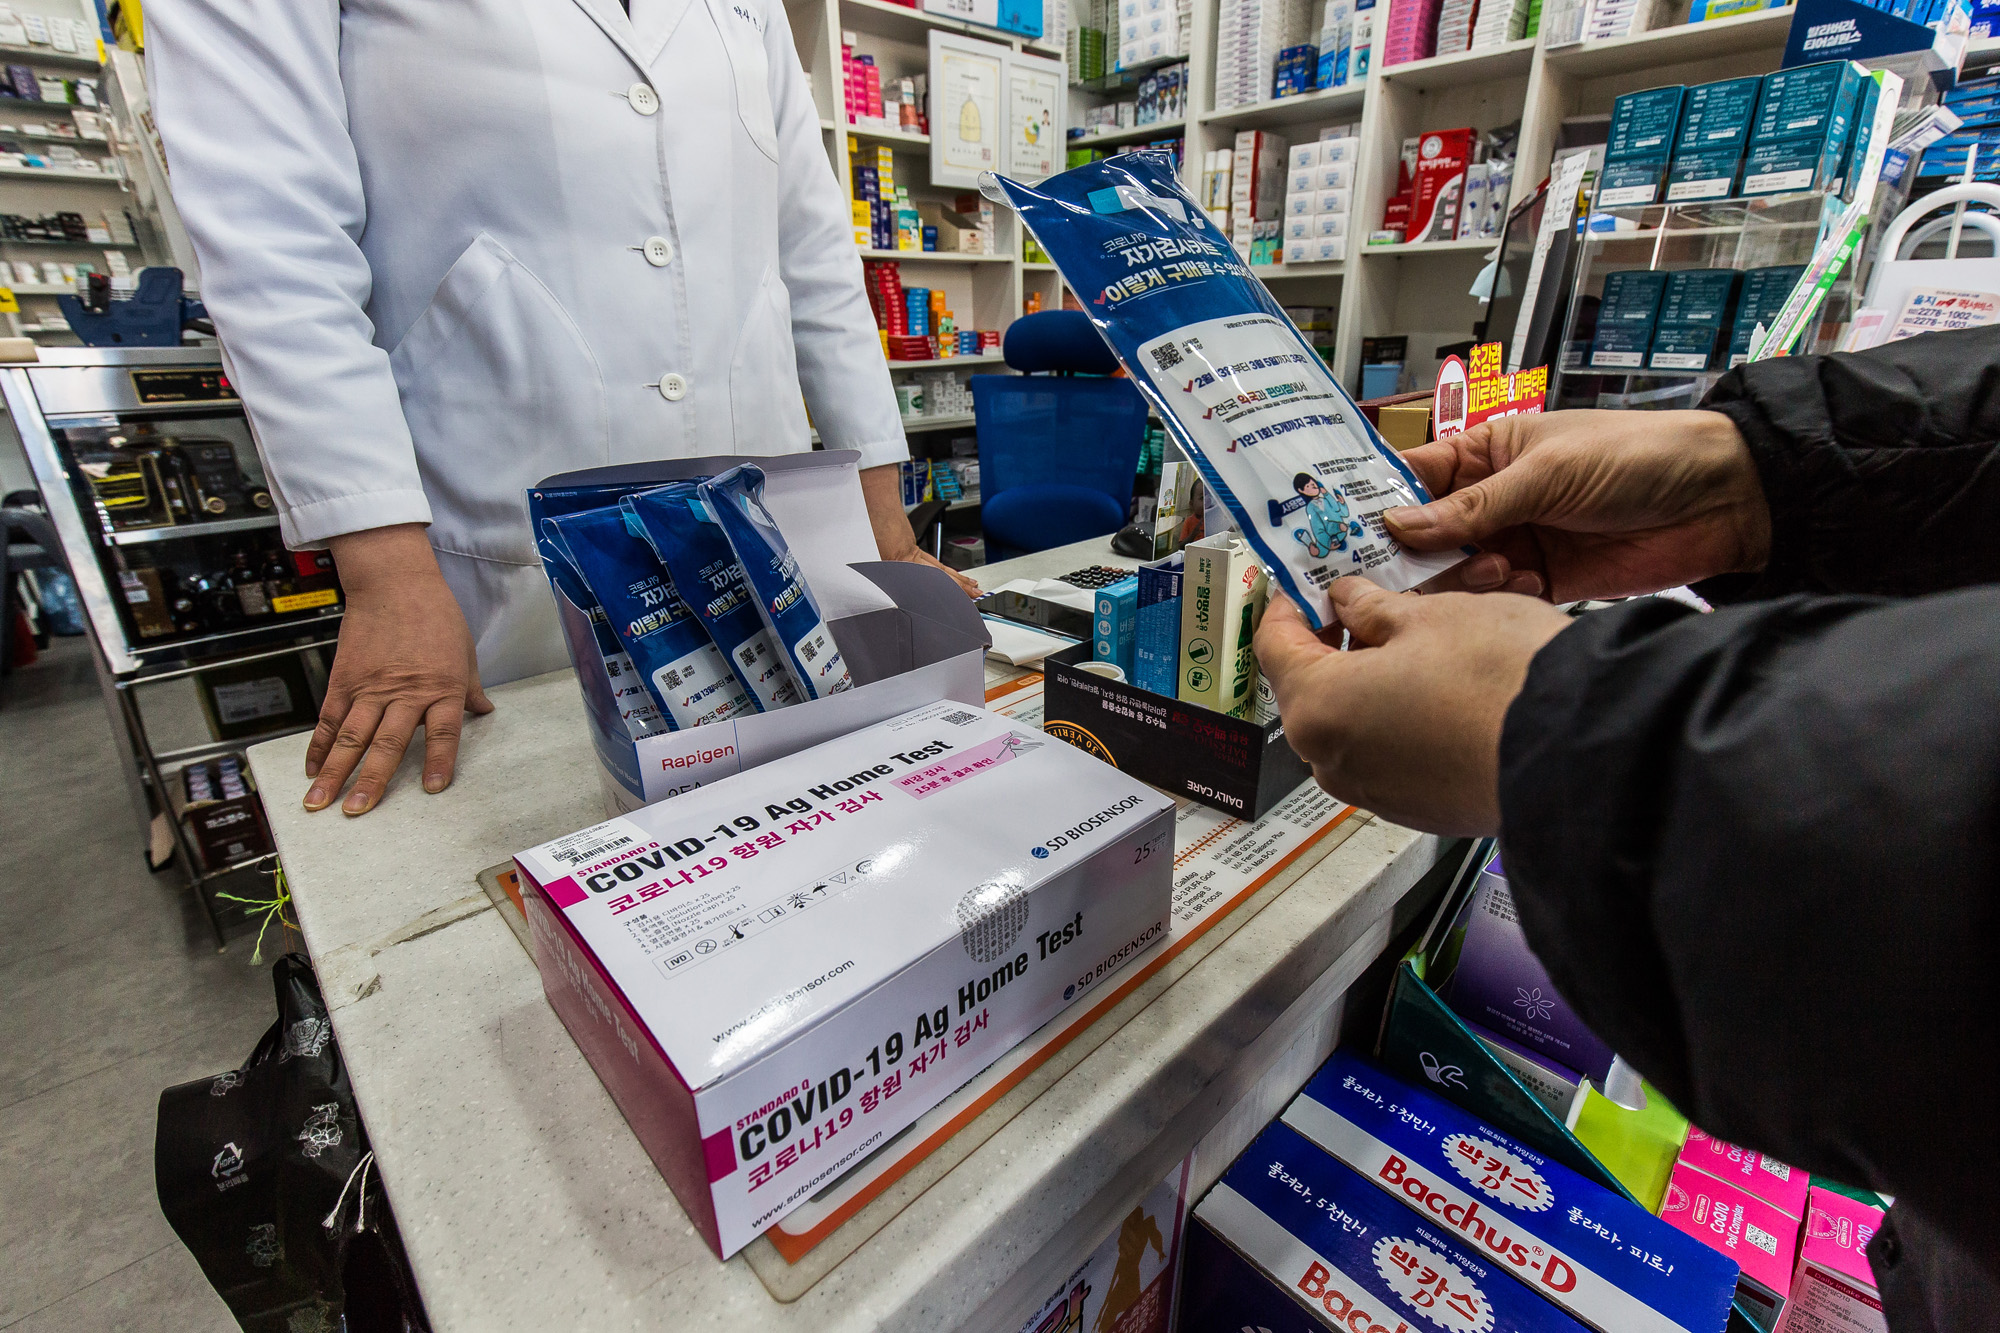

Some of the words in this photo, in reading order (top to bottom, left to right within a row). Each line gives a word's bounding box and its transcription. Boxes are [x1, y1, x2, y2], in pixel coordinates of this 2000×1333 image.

[1103, 232, 1147, 250] 코로나19
[1105, 270, 1167, 303] 이렇게
[1163, 260, 1214, 282] 구매할
[1213, 261, 1227, 276] 수
[1194, 372, 1215, 389] 2월
[1250, 357, 1266, 371] 3월
[1265, 354, 1293, 369] 5일까지
[1468, 343, 1502, 380] 초강력
[1212, 397, 1240, 418] 전국
[1265, 381, 1309, 400] 편의점에서
[1468, 365, 1548, 414] 피로회복&피부탄력
[1236, 428, 1258, 449] 1인
[1256, 426, 1275, 443] 1회
[1271, 417, 1307, 437] 5개까지
[1312, 463, 1324, 477] 1
[1339, 484, 1350, 498] 2
[1357, 514, 1368, 529] 3
[1351, 549, 1362, 565] 4
[1303, 571, 1315, 586] 5
[707, 589, 740, 617] 이렇게
[773, 583, 802, 613] 이렇게
[1195, 585, 1210, 627] 활명수
[630, 608, 673, 637] 이렇게
[631, 706, 650, 719] 전국
[1145, 713, 1167, 730] 백수오
[661, 744, 735, 772] Rapigen
[900, 773, 922, 787] 비강
[922, 765, 947, 779] 검사
[914, 780, 942, 796] 15분
[941, 775, 953, 784] 후
[951, 765, 975, 779] 결과
[970, 756, 996, 770] 확인
[1187, 779, 1214, 798] CARE
[1214, 790, 1244, 809] DAILY
[1271, 806, 1285, 818] MIA
[1282, 799, 1293, 811] Vita
[1299, 784, 1319, 799] Balance
[1281, 811, 1294, 822] MIA
[1291, 802, 1308, 816] Kinder
[1305, 790, 1325, 805] Balance
[1300, 819, 1313, 830] MIA
[1310, 809, 1327, 824] Kinder
[1325, 800, 1340, 814] Chew
[1311, 796, 1331, 811] Balance
[585, 815, 761, 894] COVID-19
[764, 797, 813, 821] Ag
[807, 762, 895, 801] Home
[889, 739, 955, 766] Test
[1046, 835, 1069, 852] SD
[1064, 794, 1145, 842] BIOSENSOR
[606, 856, 728, 916] 코로나19
[729, 830, 787, 861] 항원
[784, 809, 837, 836] 자가
[834, 789, 884, 814] 검사
[1133, 841, 1151, 866] 25
[1211, 850, 1224, 862] MIA
[1221, 840, 1236, 855] Joint
[1233, 827, 1256, 844] Balance
[1251, 820, 1268, 833] Gold
[1220, 855, 1233, 867] MIA
[1231, 849, 1243, 860] NB
[1239, 839, 1257, 854] GOLD
[1230, 859, 1244, 871] MIA
[1240, 852, 1253, 864] Fem
[1252, 837, 1275, 855] Balance
[1272, 830, 1286, 842] Plus
[577, 844, 647, 878] STANDARD
[648, 840, 661, 852] Q
[1240, 864, 1254, 876] MIA
[1252, 856, 1265, 869] Max
[1202, 869, 1217, 883] Gold
[666, 901, 704, 923] (Solution
[703, 892, 725, 908] tube)
[671, 911, 702, 928] (Nozzle
[701, 901, 720, 913] cap)
[1172, 903, 1186, 916] MIA
[1184, 889, 1207, 908] Omega
[1181, 909, 1195, 922] MIA
[1193, 901, 1205, 913] BR
[1202, 890, 1223, 907] Focus
[669, 954, 688, 967] IVD
[1077, 971, 1094, 992] SD
[1095, 921, 1162, 979] BIOSENSOR
[711, 957, 857, 1044] www.sdosensor.com
[739, 1031, 904, 1162] COVID-19
[912, 1004, 949, 1049] Ag
[957, 952, 1029, 1017] Home
[1035, 911, 1083, 961] Test
[736, 1086, 798, 1131] STANDARD
[801, 1078, 810, 1091] Q
[747, 1107, 855, 1194] 코로나19
[858, 1068, 903, 1116] 항원
[907, 1038, 949, 1079] 자가
[953, 1007, 990, 1049] 검사
[1342, 1074, 1385, 1113] 풀려라,
[1478, 1125, 1508, 1145] 피로회복
[1513, 1144, 1545, 1166] 자양강장
[220, 1155, 236, 1169] HDPE
[1456, 1139, 1540, 1200] 박카스
[751, 1129, 883, 1230] www.sdbiosensor.com
[1267, 1160, 1314, 1205] 풀려라,
[1477, 1174, 1502, 1192] D
[1709, 1201, 1730, 1235] CoQ10
[1729, 1203, 1745, 1235] Complex
[1415, 1226, 1449, 1251] 피로회복
[1452, 1252, 1488, 1278] 자양강장
[1567, 1205, 1623, 1251] 풀려라,
[1629, 1245, 1674, 1277] 피로!
[1725, 1231, 1738, 1250] Poll
[1388, 1244, 1480, 1323] 박카스
[1408, 1287, 1435, 1308] D
[1814, 1272, 1834, 1286] Daily
[1835, 1282, 1861, 1299] intake
